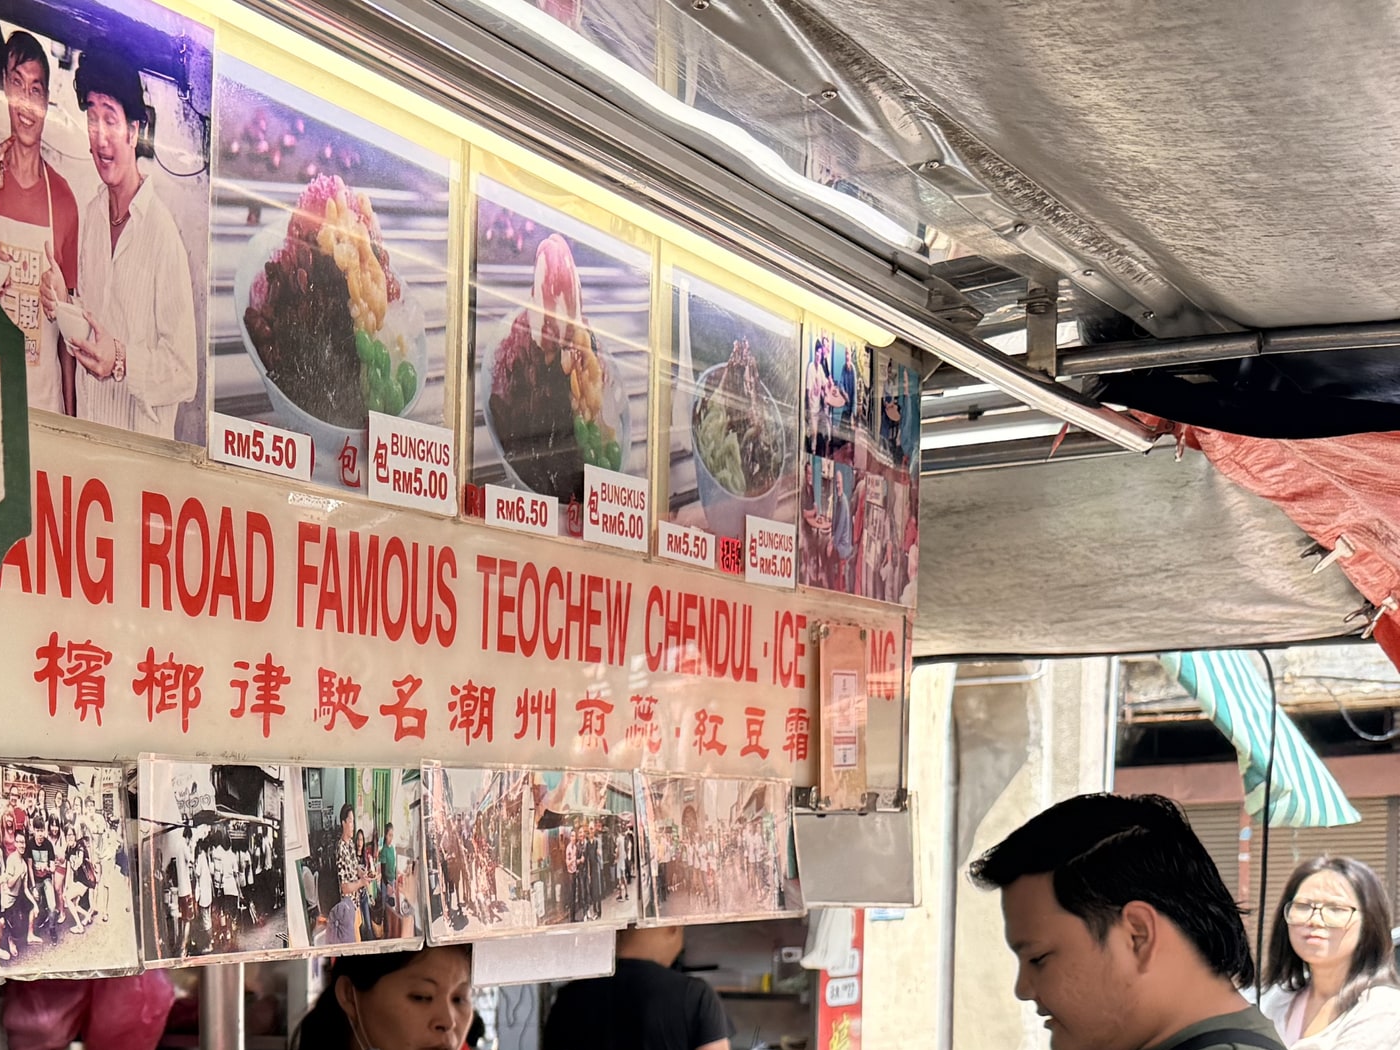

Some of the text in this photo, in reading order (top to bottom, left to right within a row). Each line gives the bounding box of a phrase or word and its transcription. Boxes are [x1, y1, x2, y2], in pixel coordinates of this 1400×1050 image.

[224, 429, 297, 469] RM5.50
[338, 435, 361, 488] 包
[373, 436, 390, 483] 包
[391, 432, 450, 467] BUNGKUS
[392, 467, 448, 500] RM5.00
[600, 482, 646, 511] BUNGKUS
[496, 496, 548, 527] RM6.50
[587, 484, 600, 526] 包
[602, 511, 643, 540] RM6.00
[758, 530, 793, 553] BUNGKUS
[667, 532, 707, 561] RM5.50
[759, 554, 792, 578] RM5.00
[141, 490, 274, 622] ROAD
[296, 520, 457, 648] FAMOUS
[476, 554, 632, 667] TEOCHEW
[644, 584, 758, 683] CHENDUL
[773, 609, 806, 688] ICE
